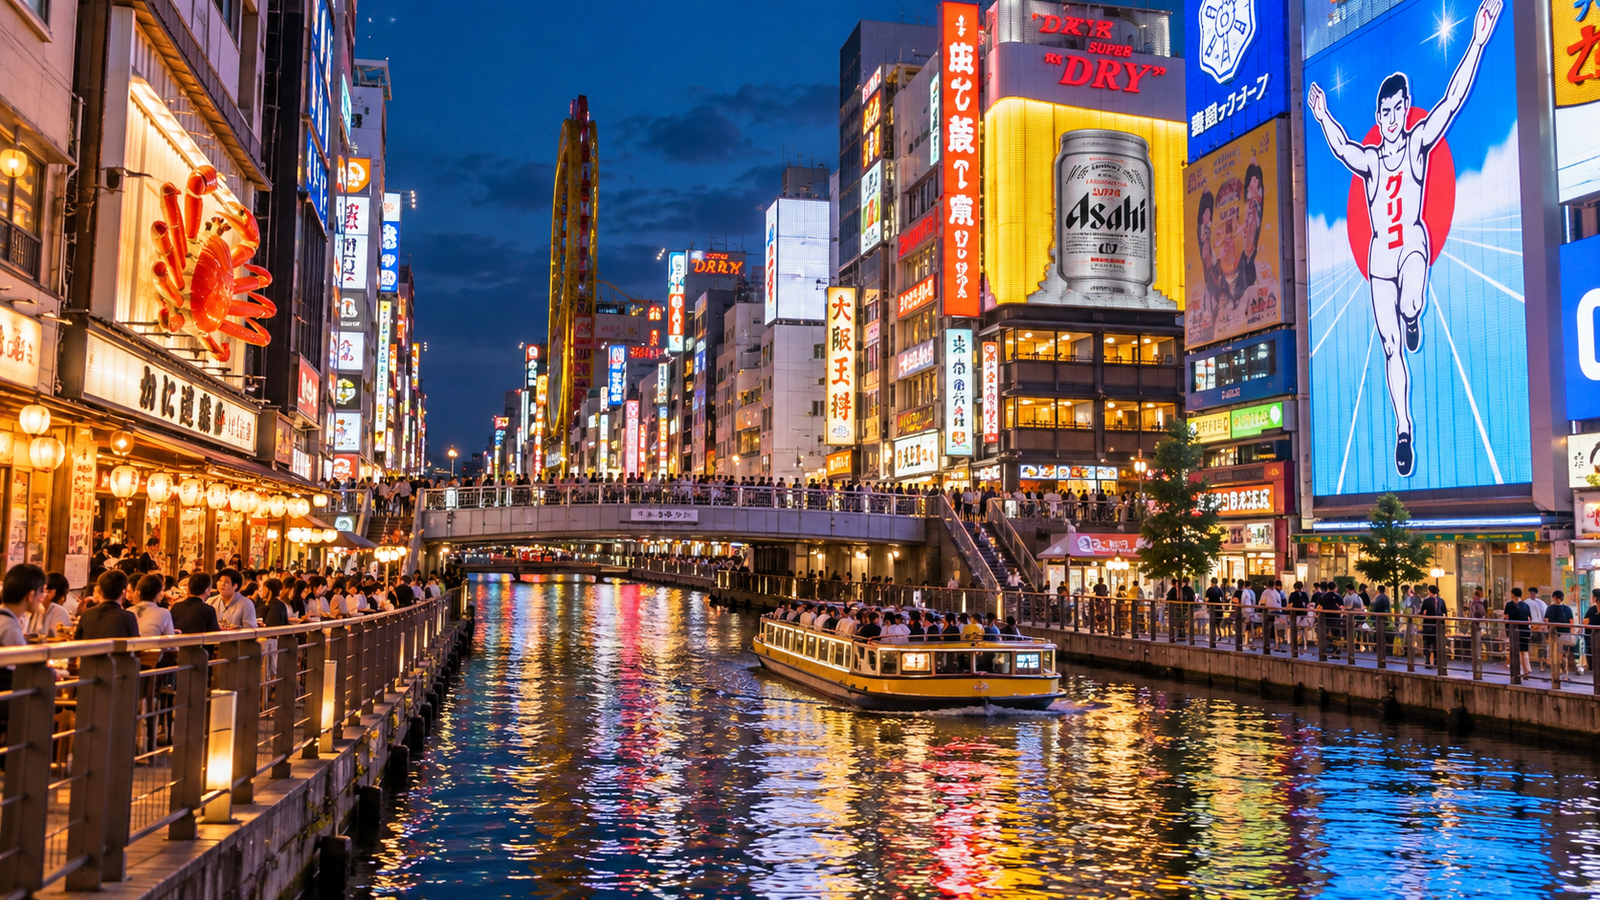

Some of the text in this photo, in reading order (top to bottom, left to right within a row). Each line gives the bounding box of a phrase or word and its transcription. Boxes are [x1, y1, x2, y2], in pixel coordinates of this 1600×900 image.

[1065, 191, 1146, 234] Asahi
[1386, 171, 1404, 249] グリコ
